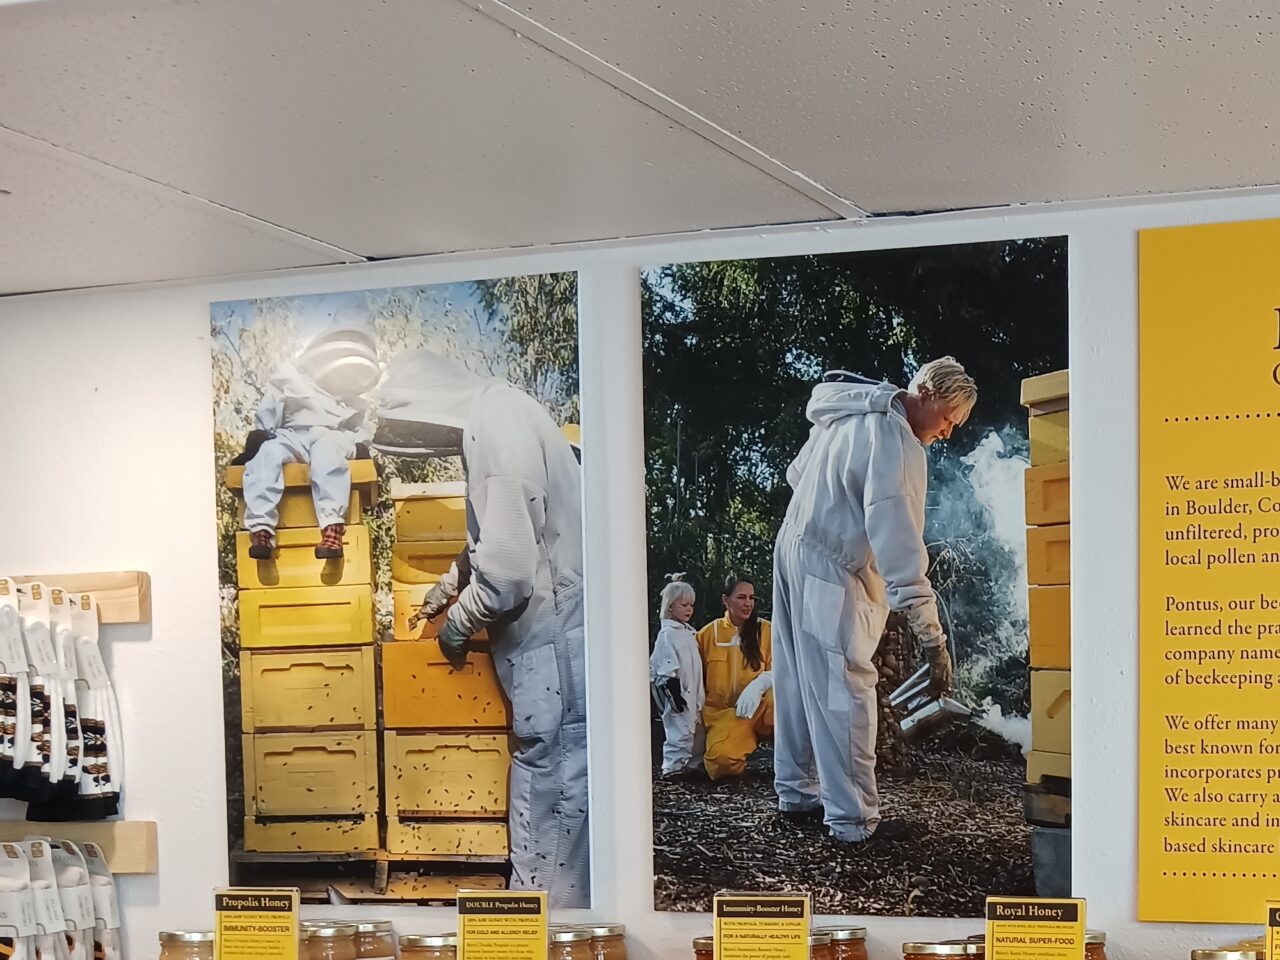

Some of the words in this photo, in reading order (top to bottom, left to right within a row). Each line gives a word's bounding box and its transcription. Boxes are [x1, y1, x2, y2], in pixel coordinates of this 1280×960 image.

[1165, 475, 1190, 491] We
[1195, 479, 1219, 490] are
[1165, 501, 1180, 516] in
[1186, 497, 1253, 516] Boulder,
[1165, 522, 1248, 541] unfiltered,
[1165, 548, 1202, 566] local
[1206, 547, 1256, 570] pollen
[222, 896, 259, 910] Propolis
[260, 897, 290, 910] Honey
[722, 904, 781, 914] Immunity-Booster
[781, 904, 802, 914] Honey
[996, 904, 1026, 919] Royal
[1028, 905, 1064, 920] Honey
[995, 936, 1028, 944] NATURAL
[1028, 936, 1075, 945] SUPER-FOOD
